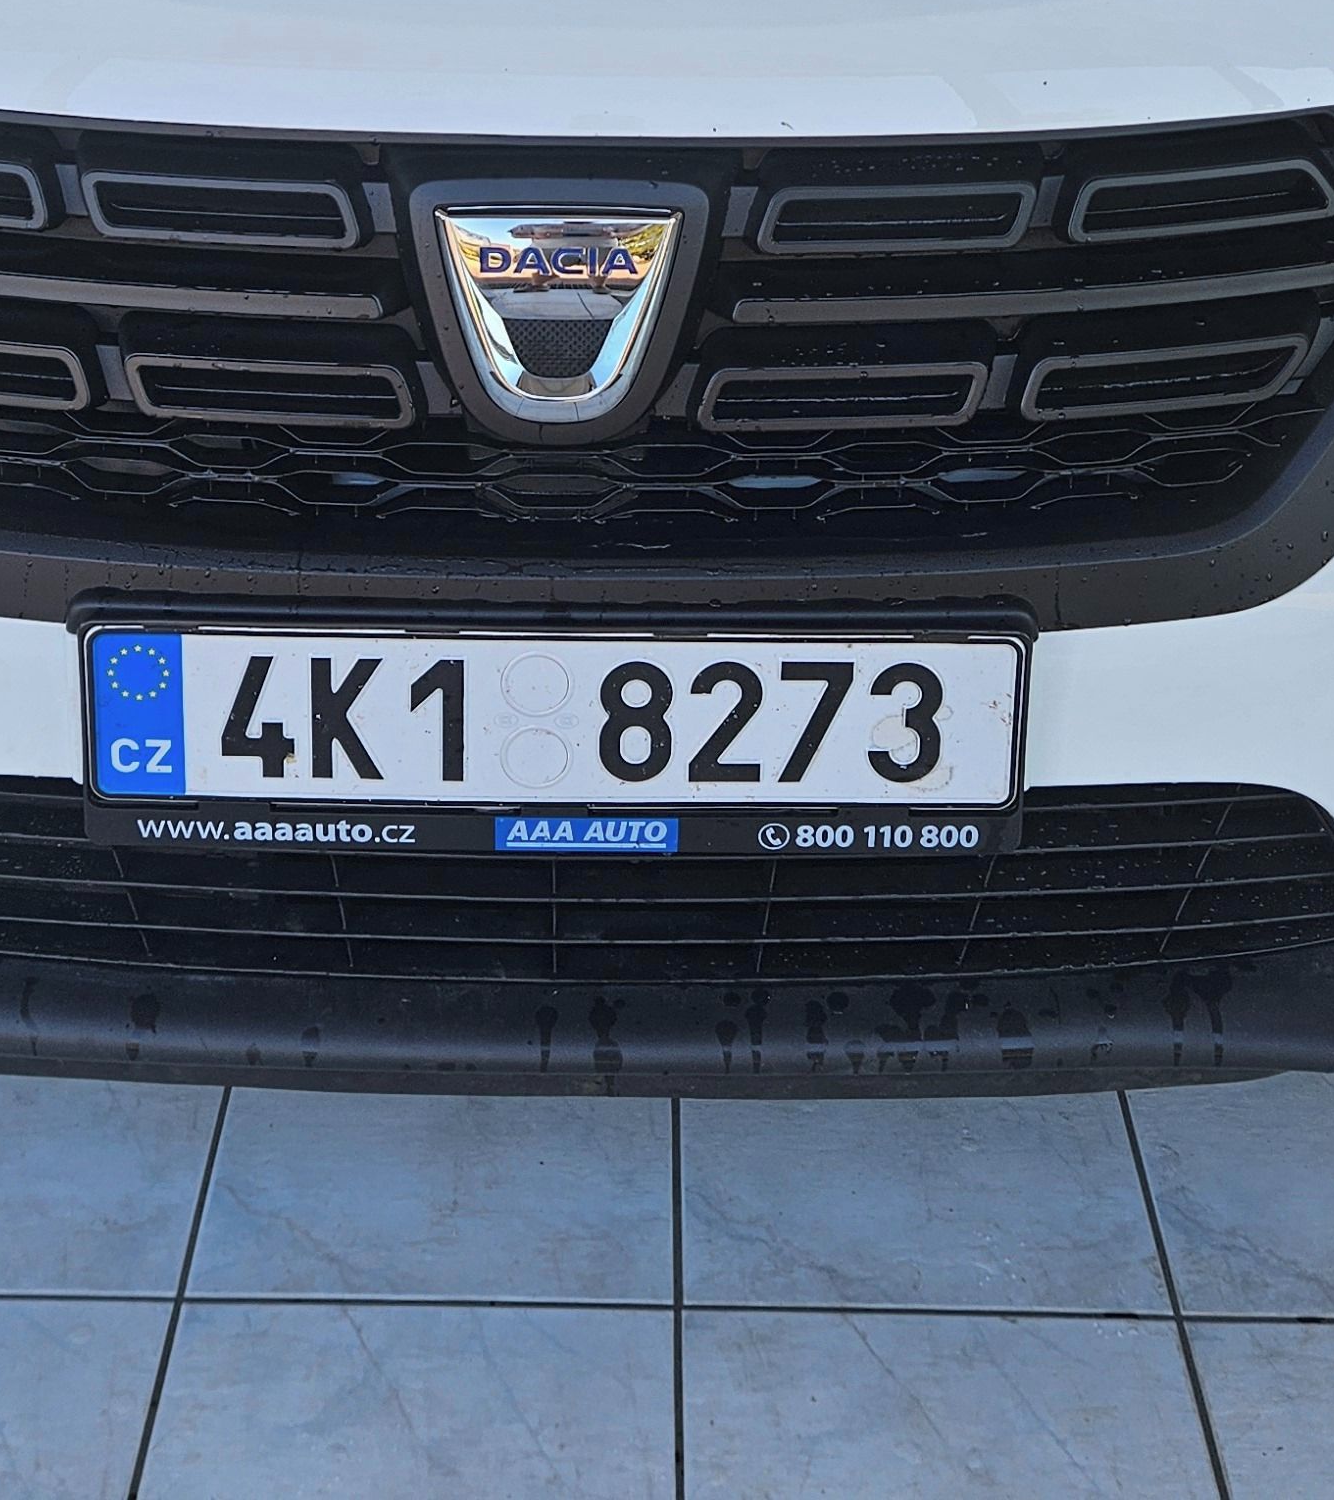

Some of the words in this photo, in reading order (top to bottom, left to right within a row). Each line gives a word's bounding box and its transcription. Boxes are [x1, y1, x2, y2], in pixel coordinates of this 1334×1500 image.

[479, 246, 637, 276] DACIA
[221, 655, 465, 782] 4K1
[599, 660, 944, 783] 8273
[110, 738, 173, 774] CZ
[137, 818, 416, 844] www.aaaauto.cz
[507, 820, 574, 842] AAA
[583, 820, 668, 842] AUTO
[794, 825, 854, 849] 800
[863, 825, 913, 849] 110
[919, 825, 980, 849] 800
